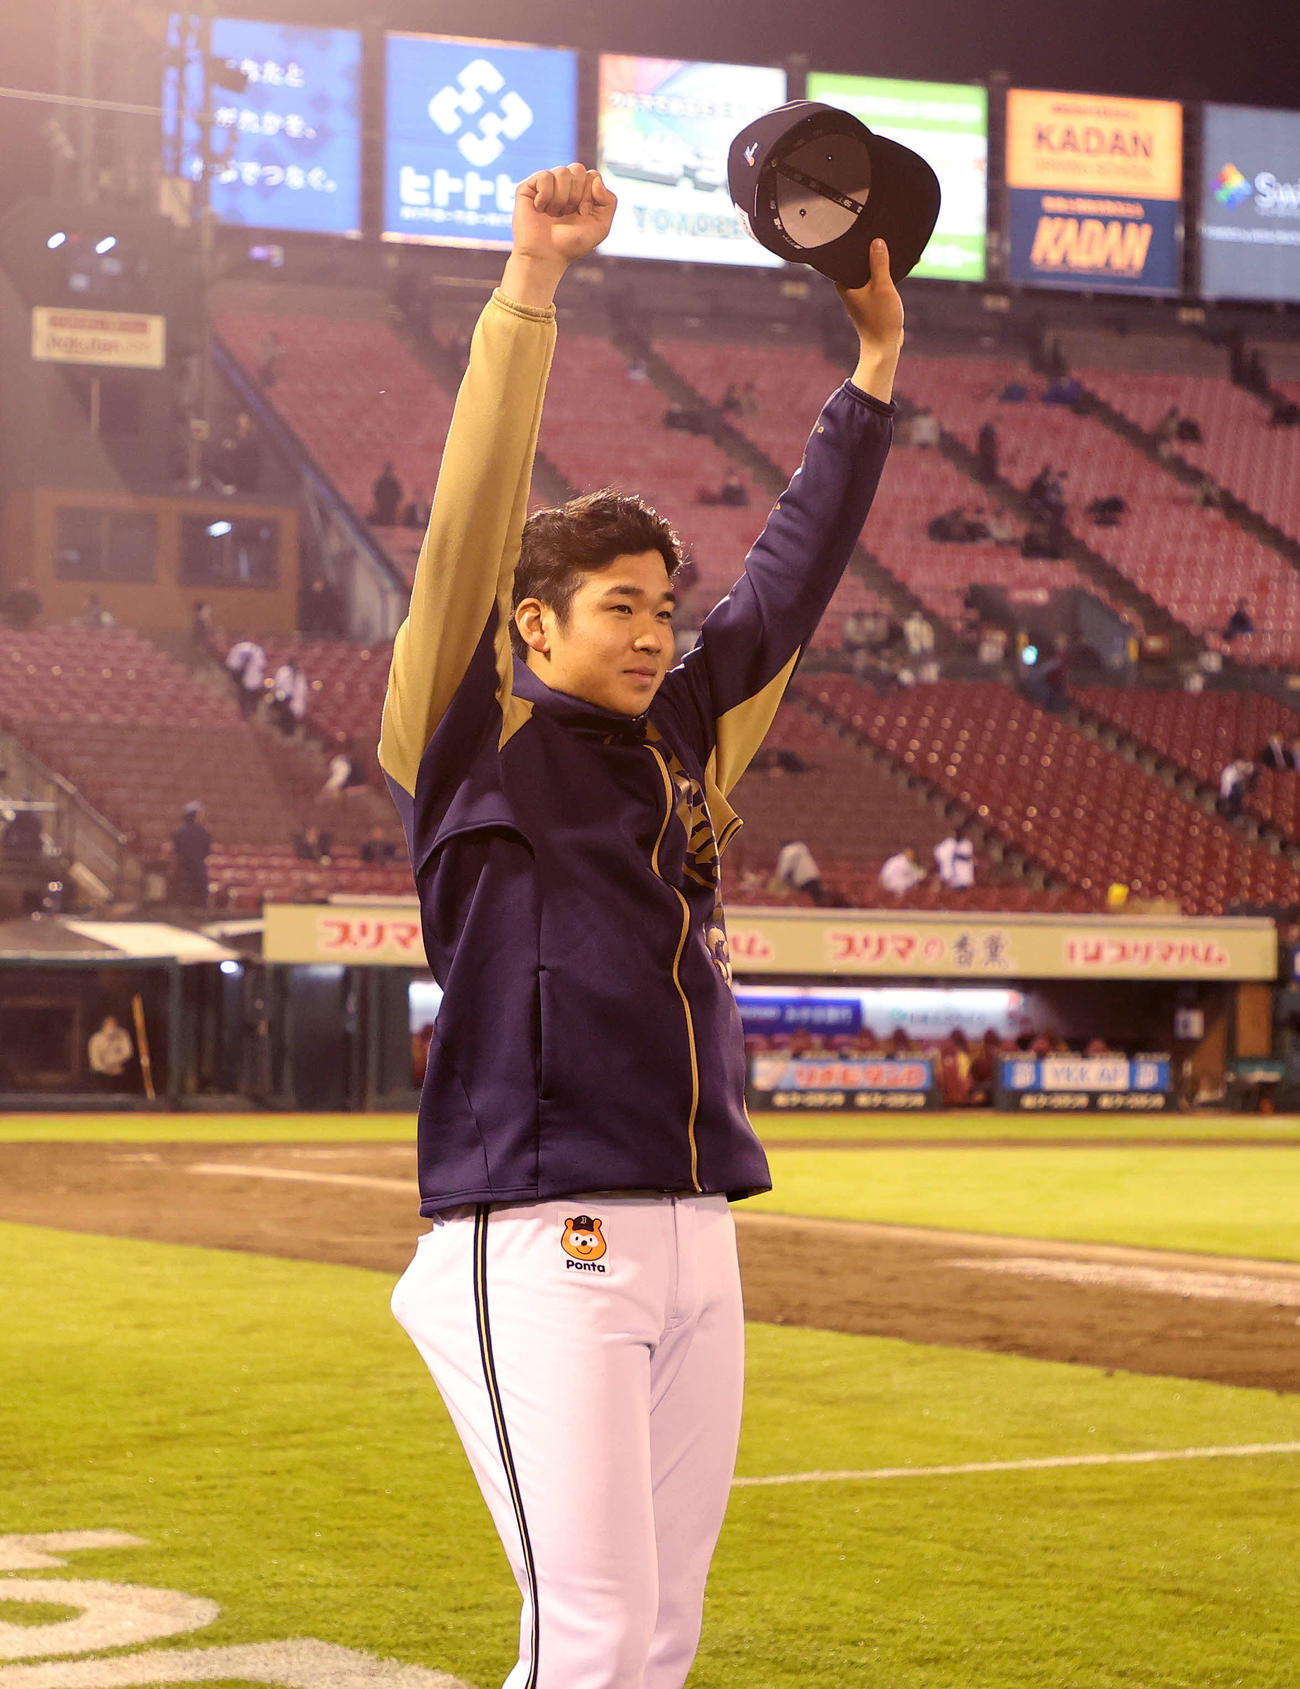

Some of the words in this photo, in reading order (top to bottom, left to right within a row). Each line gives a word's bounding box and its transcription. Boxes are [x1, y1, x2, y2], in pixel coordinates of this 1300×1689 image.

[1034, 123, 1154, 158] KADAN
[1030, 215, 1153, 274] KADAN
[566, 1259, 606, 1273] Ponta
